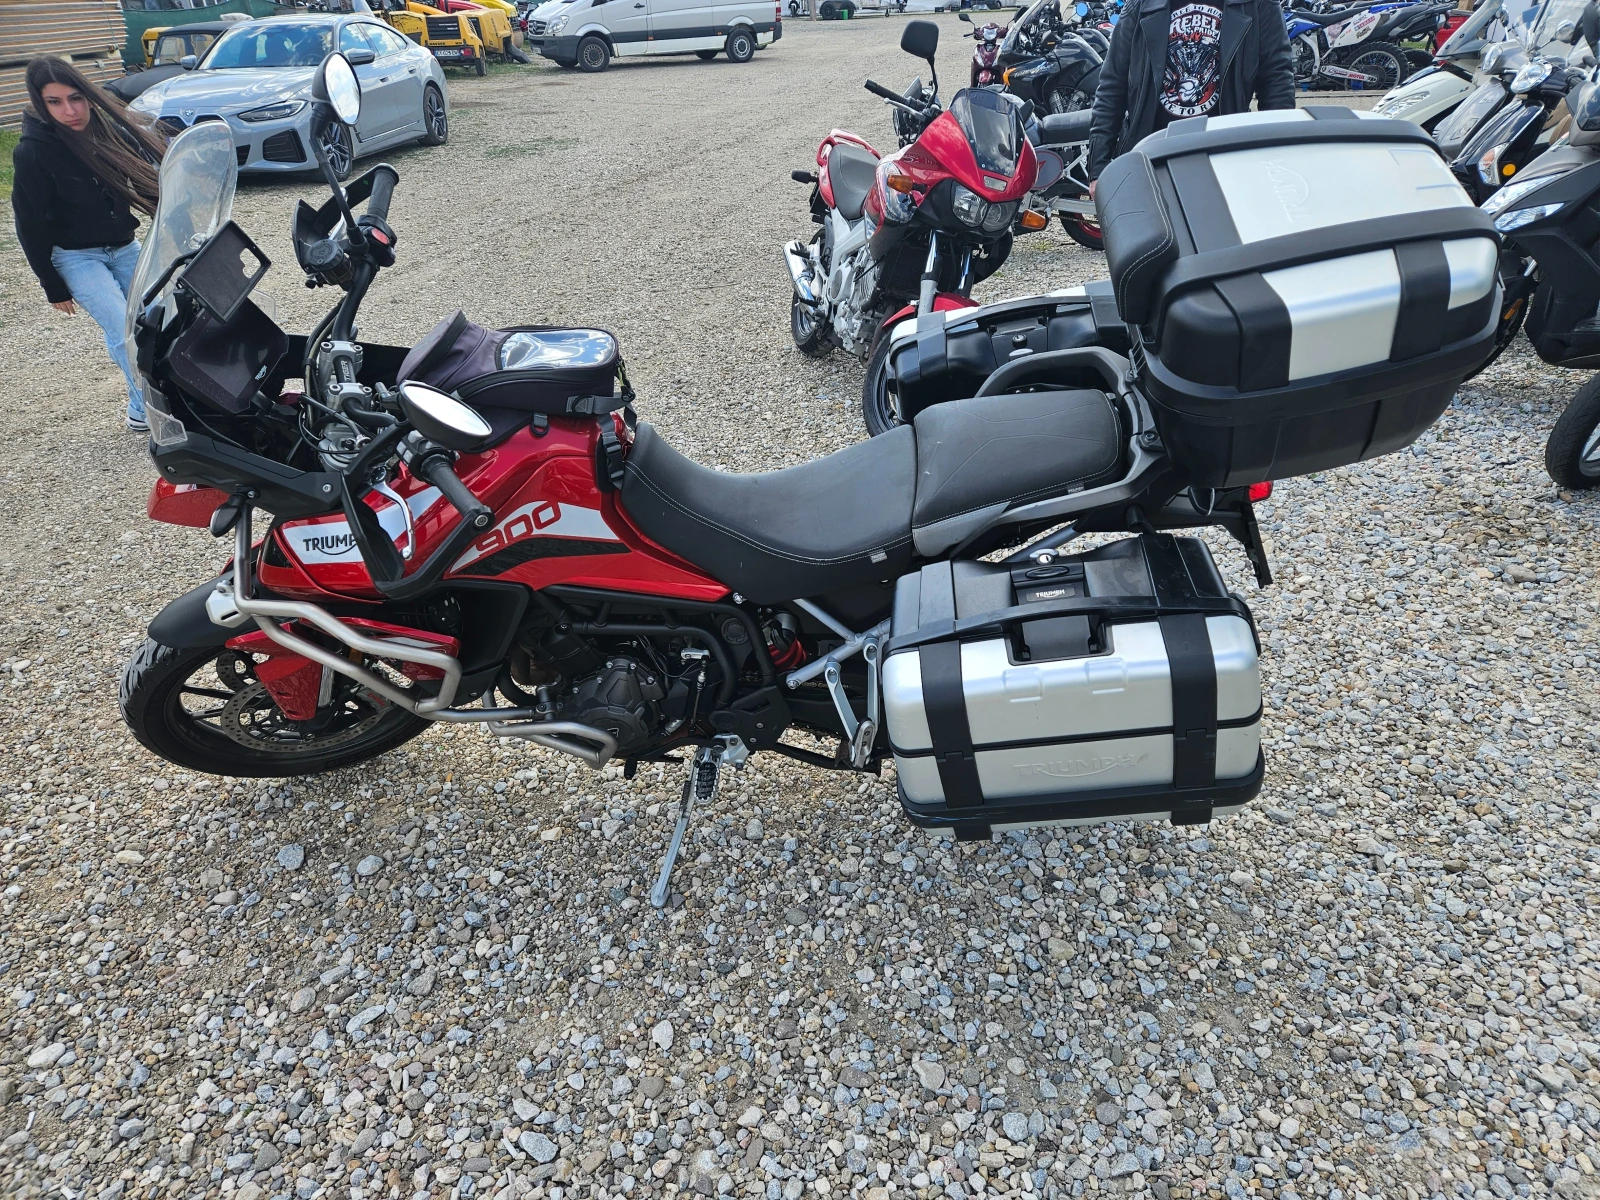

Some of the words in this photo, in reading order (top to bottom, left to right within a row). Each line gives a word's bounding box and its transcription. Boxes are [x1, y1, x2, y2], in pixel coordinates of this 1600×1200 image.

[1169, 14, 1220, 38] REBEL
[1180, 107, 1195, 115] TO
[1200, 91, 1219, 112] RID
[340, 360, 352, 382] TIGER
[475, 501, 562, 555] 900
[303, 533, 358, 555] TRIUMP
[1035, 588, 1065, 598] TRIUMPH
[1014, 754, 1135, 777] TRIUMPH
